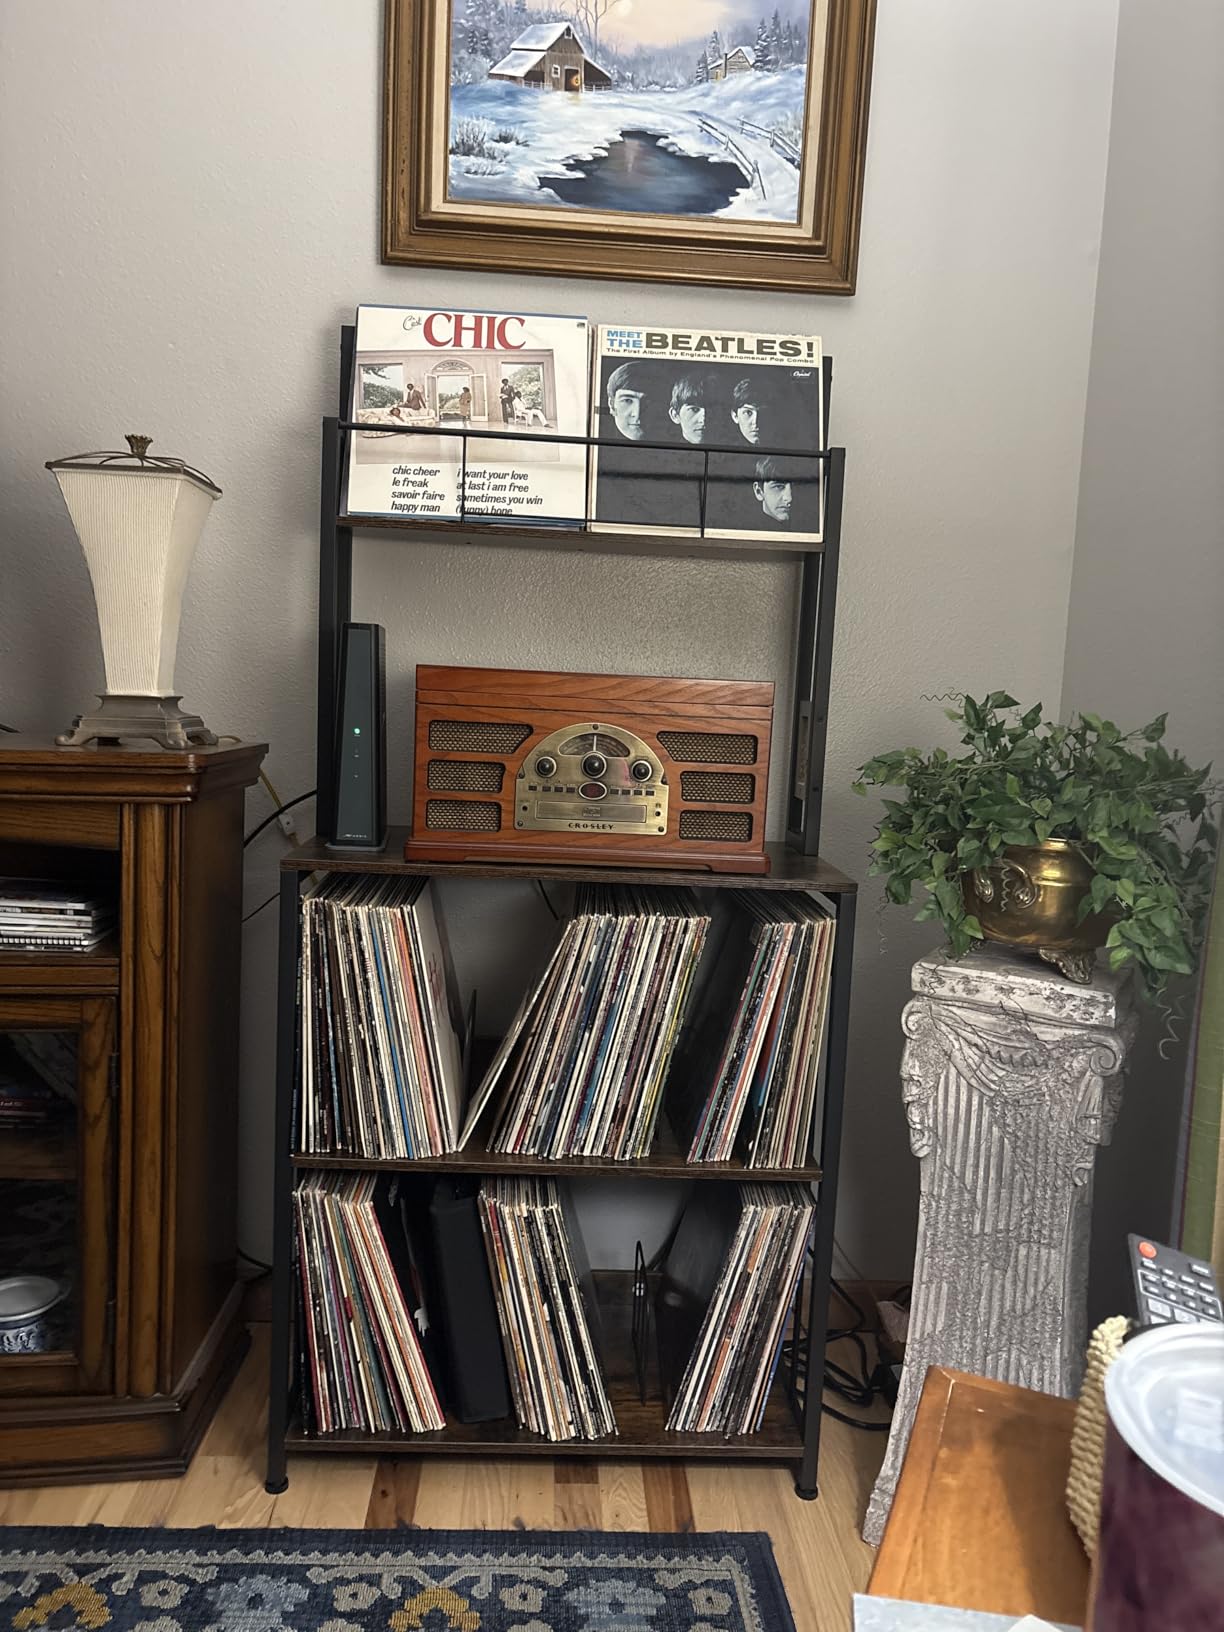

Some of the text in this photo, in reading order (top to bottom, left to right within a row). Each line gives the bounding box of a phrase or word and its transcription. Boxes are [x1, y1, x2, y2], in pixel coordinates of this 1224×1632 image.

[423, 312, 526, 350] CHIC
[607, 330, 643, 338] MEET
[607, 338, 643, 348] THE
[645, 332, 814, 358] BEATLES!
[392, 465, 440, 477] chic cheer
[457, 468, 529, 481] i want your love
[392, 477, 429, 488] le freak
[467, 481, 485, 491] last
[486, 481, 491, 491] i
[491, 483, 507, 492] am
[508, 482, 529, 493] free
[391, 489, 445, 501] savoir faire
[456, 493, 543, 506] sometimes you win
[391, 501, 440, 513] happy man
[568, 822, 614, 830] CROSLEY
